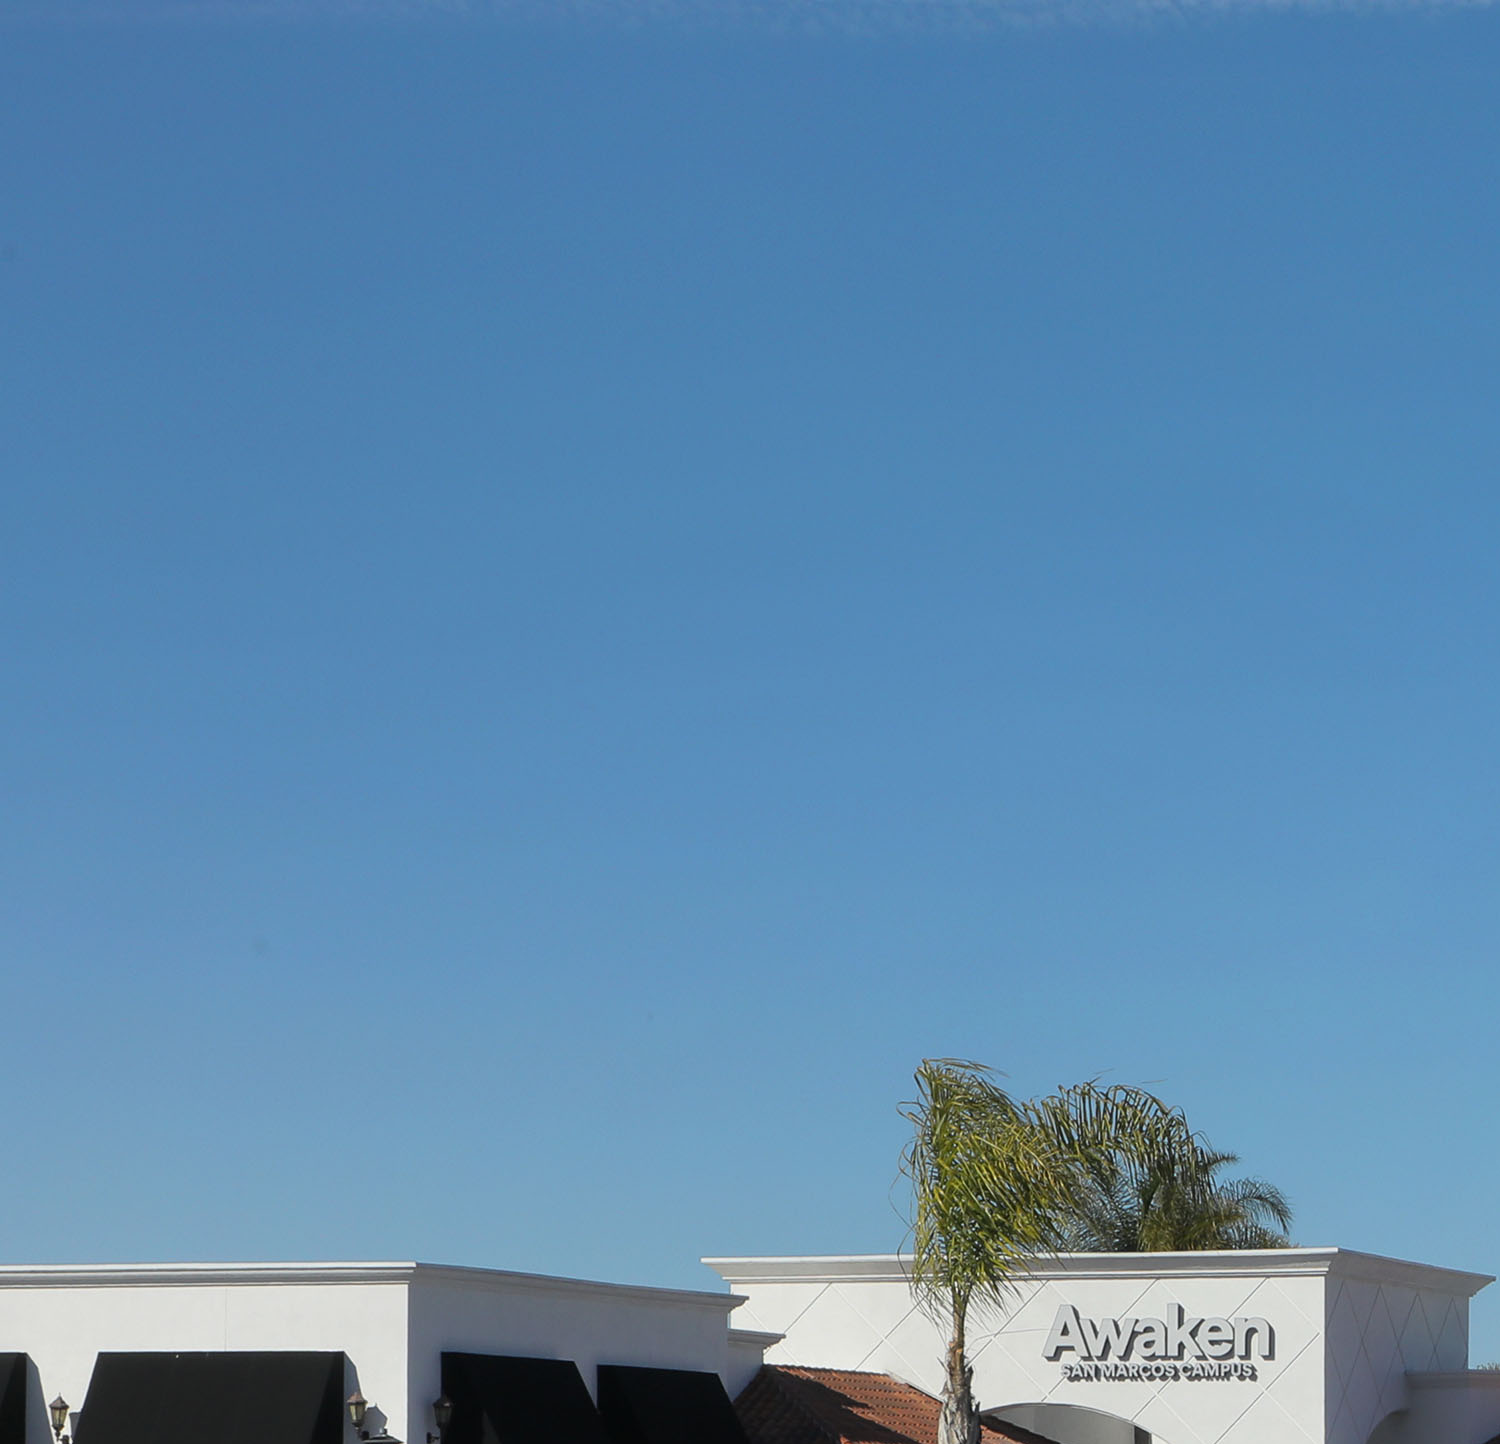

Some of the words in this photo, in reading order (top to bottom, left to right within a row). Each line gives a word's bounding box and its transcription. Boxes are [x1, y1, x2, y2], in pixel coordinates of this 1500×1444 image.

[1042, 1303, 1273, 1360] Awaken
[1061, 1363, 1098, 1380] SAN
[1099, 1363, 1177, 1380] MARCOS
[1179, 1363, 1256, 1381] CAMPUS
